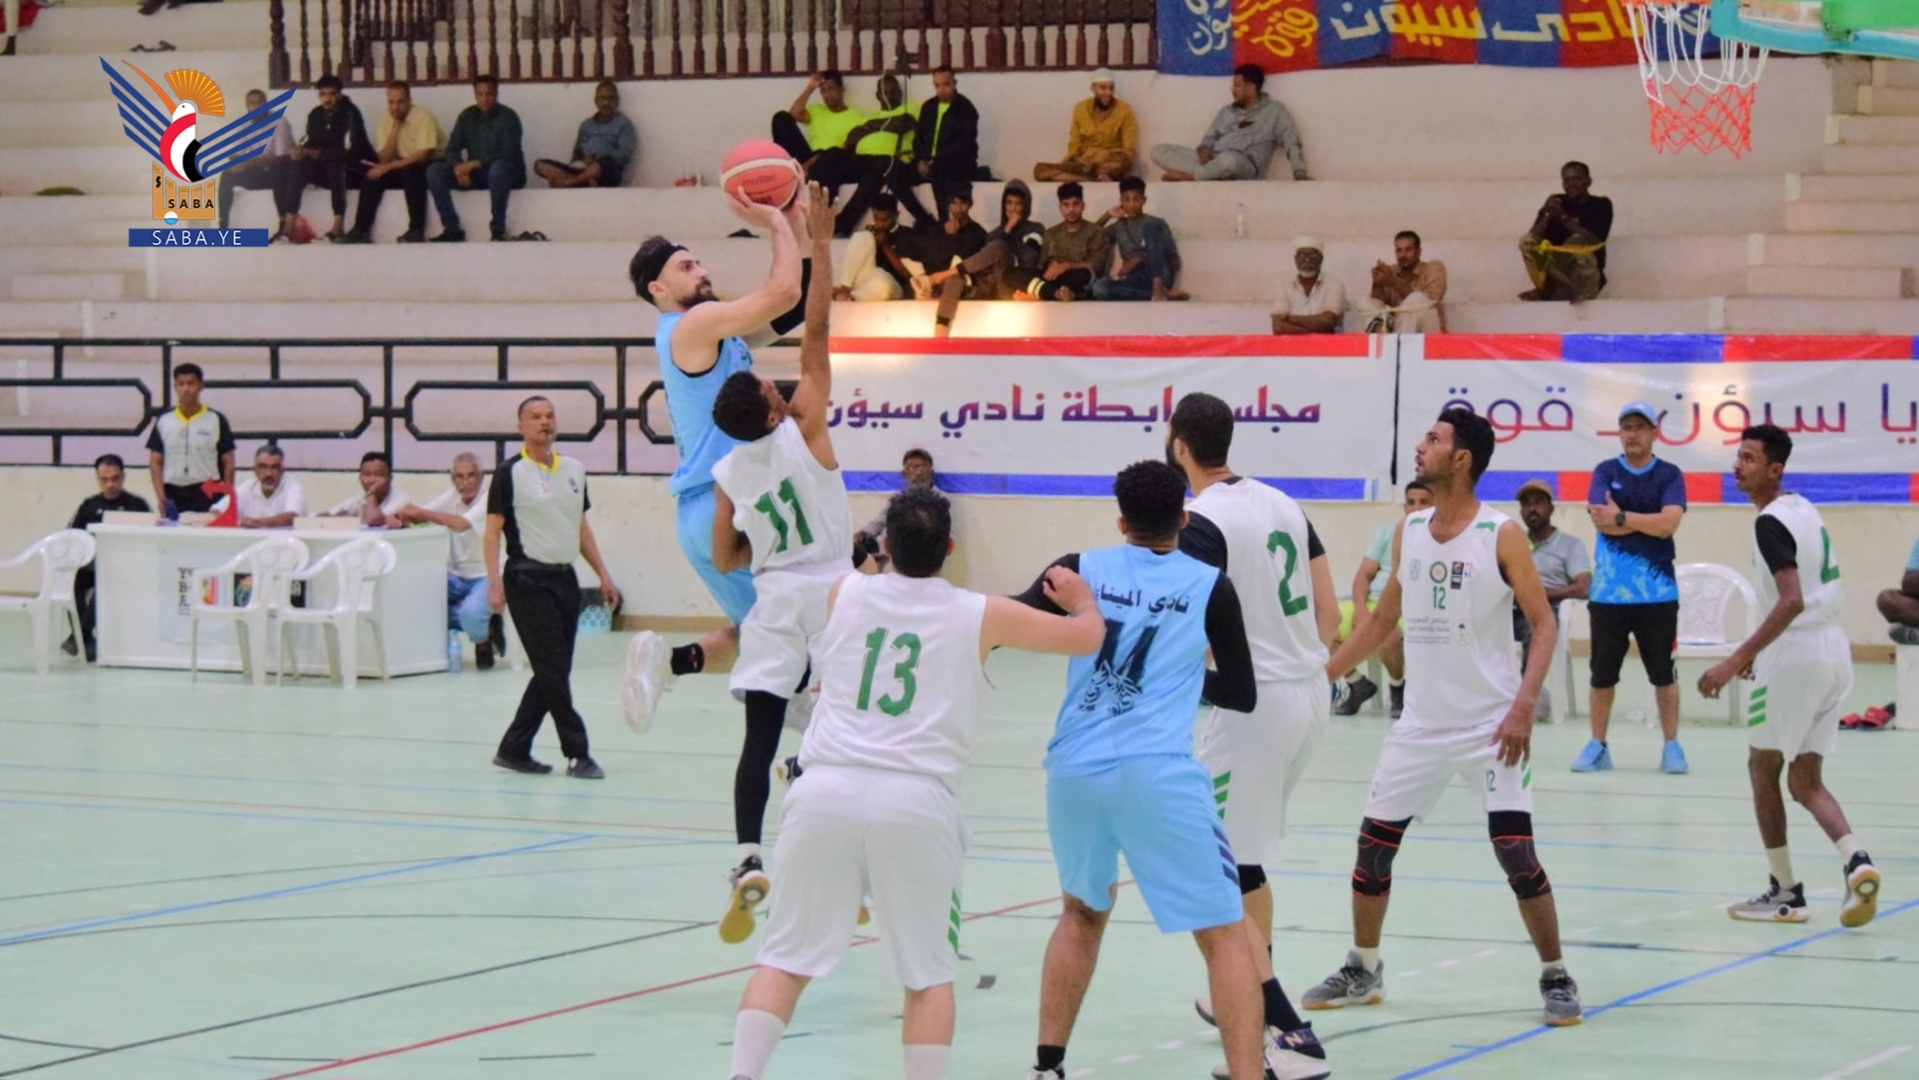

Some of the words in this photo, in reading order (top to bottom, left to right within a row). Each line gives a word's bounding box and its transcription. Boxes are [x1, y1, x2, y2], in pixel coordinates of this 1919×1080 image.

[939, 383, 1046, 439] نادي
[1062, 384, 1173, 433] ابطة
[1881, 382, 1918, 445] يا
[754, 475, 815, 554] 11
[1266, 530, 1309, 617] 2
[1432, 585, 1446, 610] 12
[1147, 594, 1190, 619] نادي
[856, 626, 922, 717] 13
